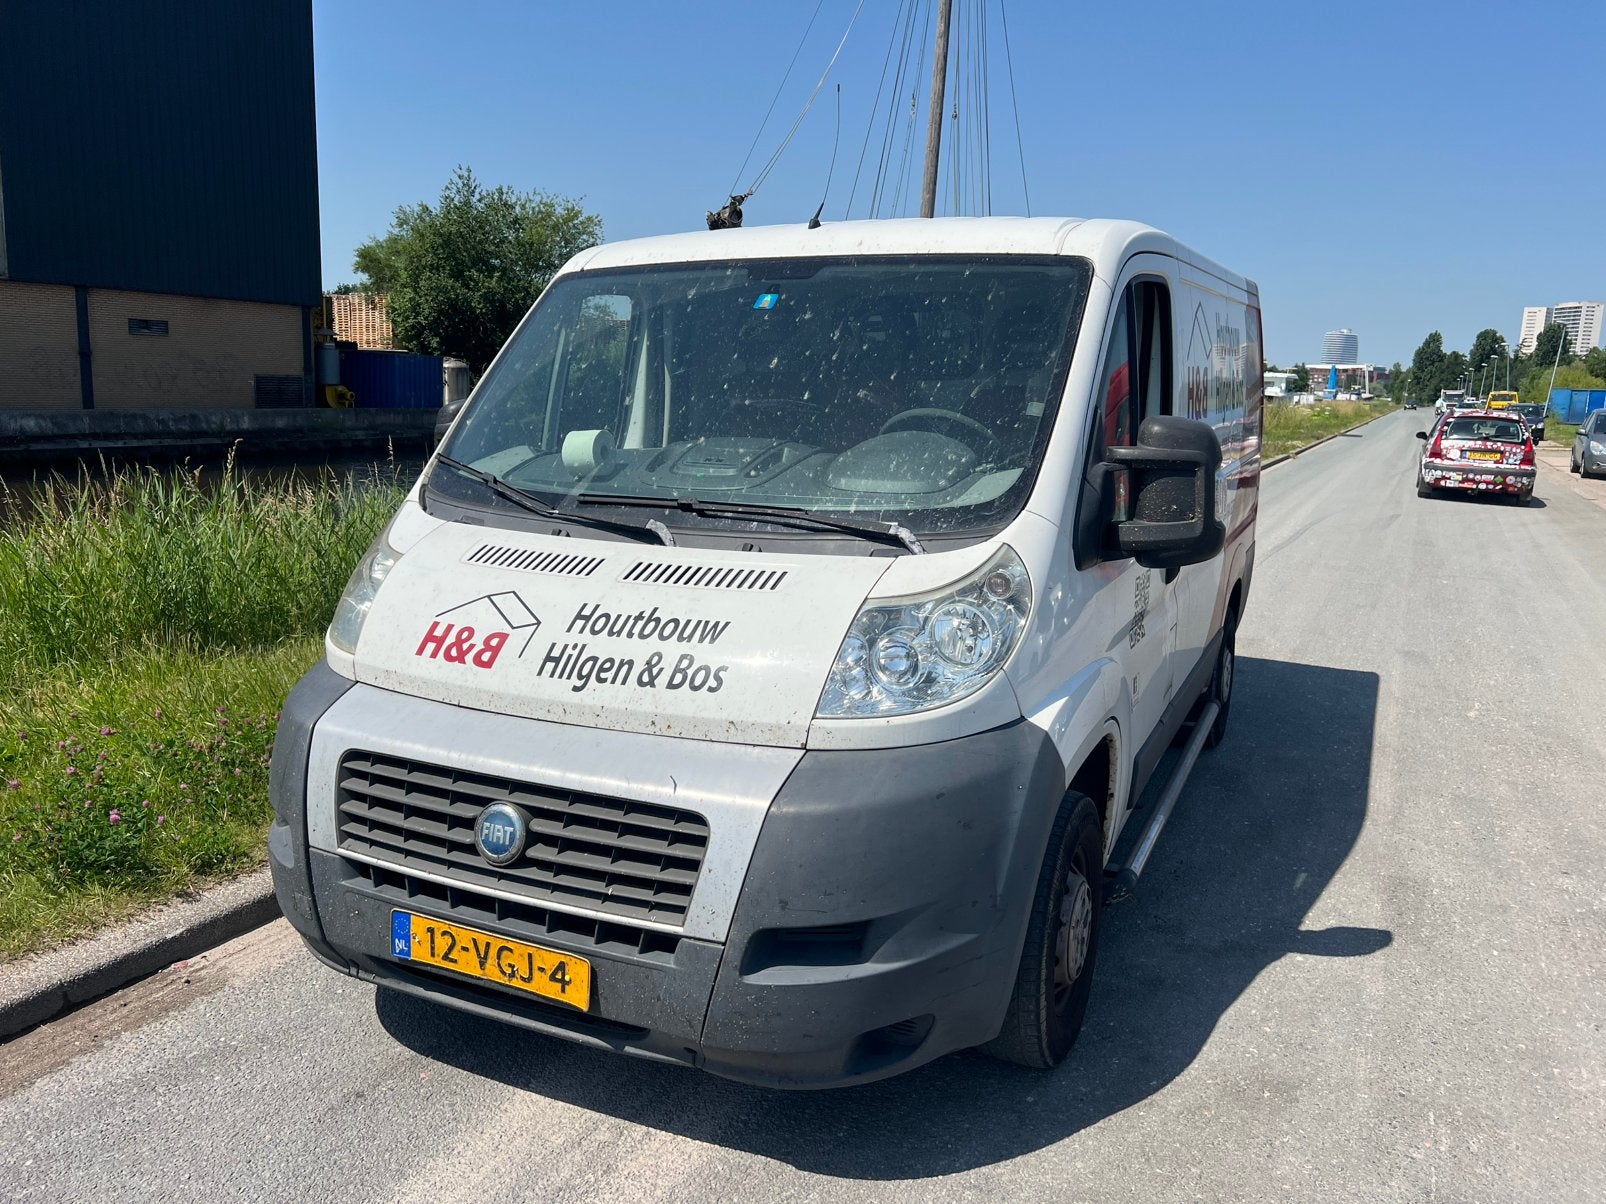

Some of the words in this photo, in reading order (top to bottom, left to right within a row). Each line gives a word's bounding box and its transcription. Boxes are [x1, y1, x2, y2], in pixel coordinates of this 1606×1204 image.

[415, 621, 510, 669] H&B
[566, 602, 731, 645] Houtbouw
[536, 642, 635, 692] Hilgen
[636, 651, 665, 689] &
[665, 653, 729, 693] Bos
[481, 822, 514, 846] FIAT
[426, 926, 572, 994] 12-VGJ-4
